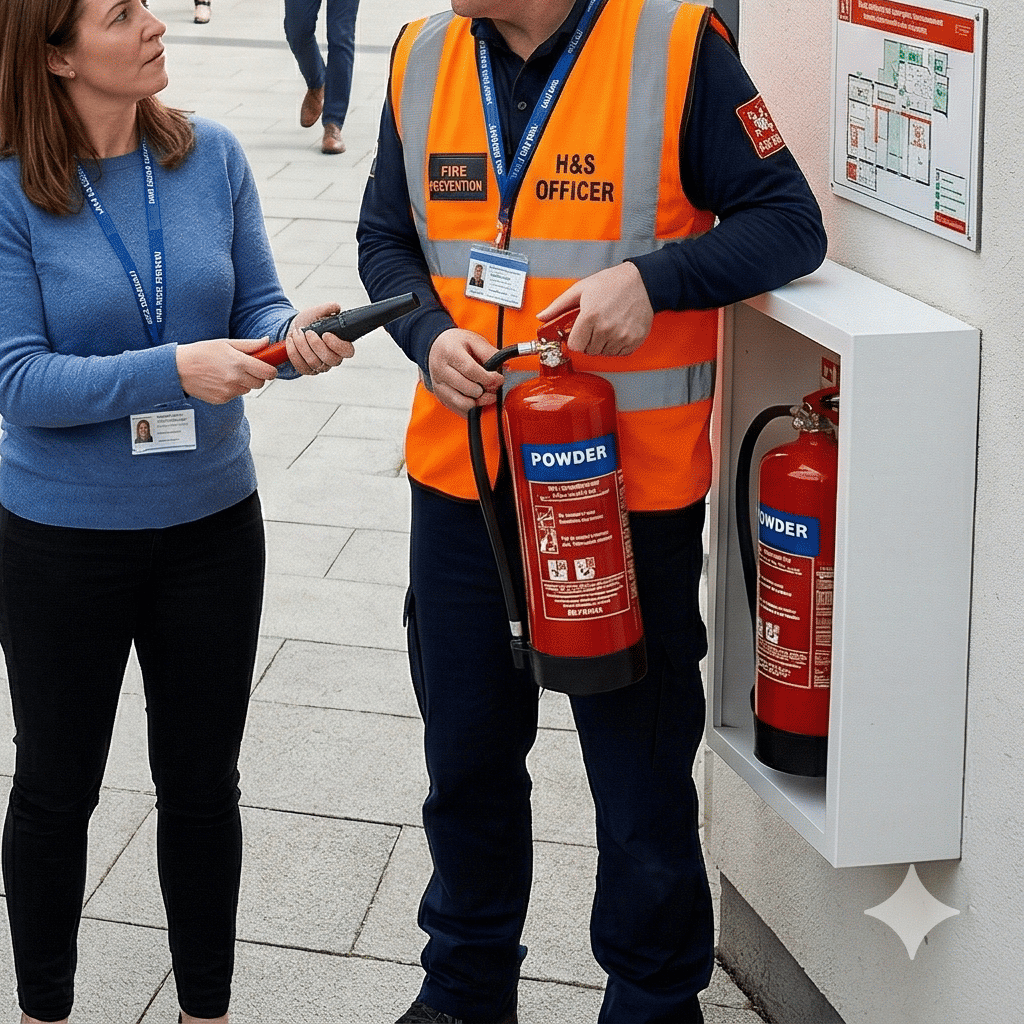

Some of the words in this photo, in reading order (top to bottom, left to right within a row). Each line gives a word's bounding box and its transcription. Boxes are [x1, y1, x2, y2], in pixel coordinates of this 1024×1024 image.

[441, 165, 468, 177] FIRE
[555, 153, 596, 175] H&S
[535, 179, 615, 203] OFFICER
[530, 444, 608, 467] POWDER
[759, 510, 808, 539] OWDER
